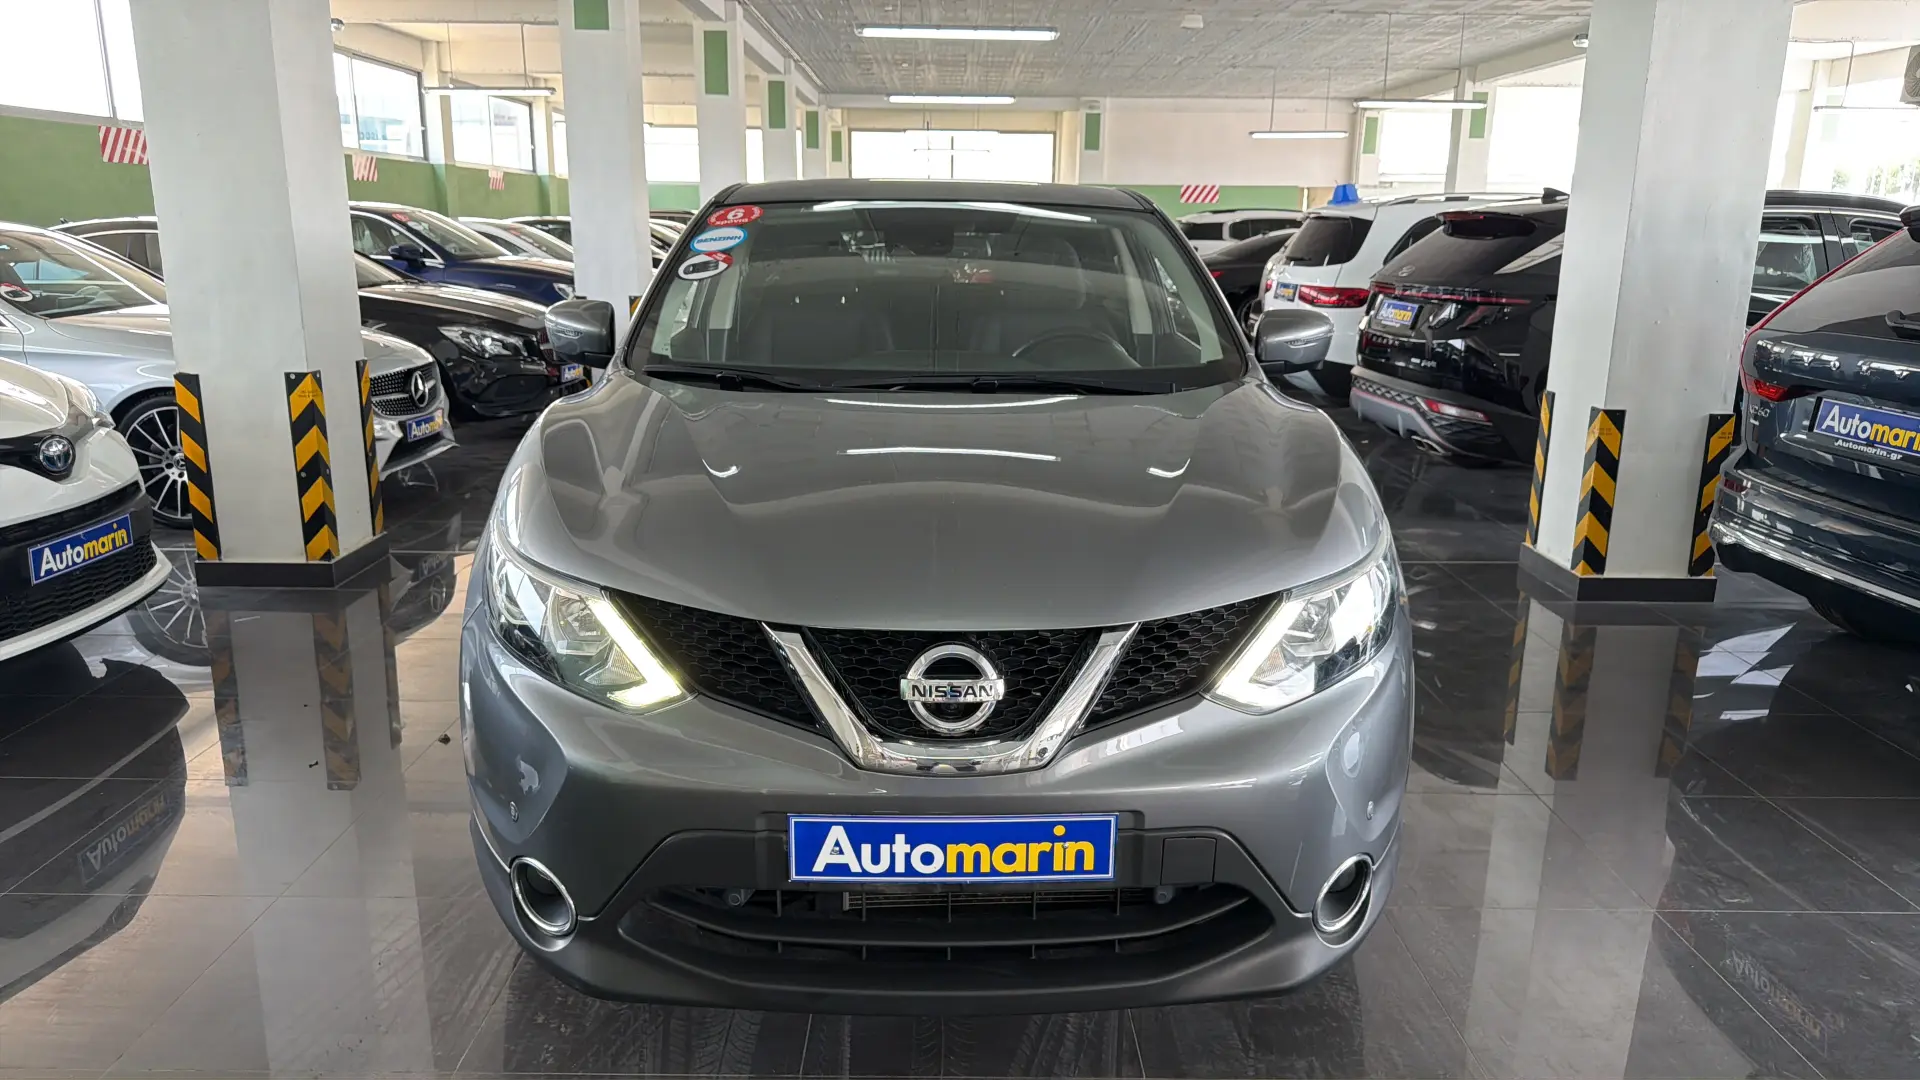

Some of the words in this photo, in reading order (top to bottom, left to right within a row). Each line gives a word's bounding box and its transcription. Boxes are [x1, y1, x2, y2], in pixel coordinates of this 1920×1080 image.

[727, 208, 745, 221] 6
[1821, 404, 1920, 451] Automari
[1834, 439, 1903, 461] Automarin.gr
[40, 522, 128, 577] Automarin
[911, 684, 993, 698] NISSAN
[812, 825, 1094, 874] Automarin
